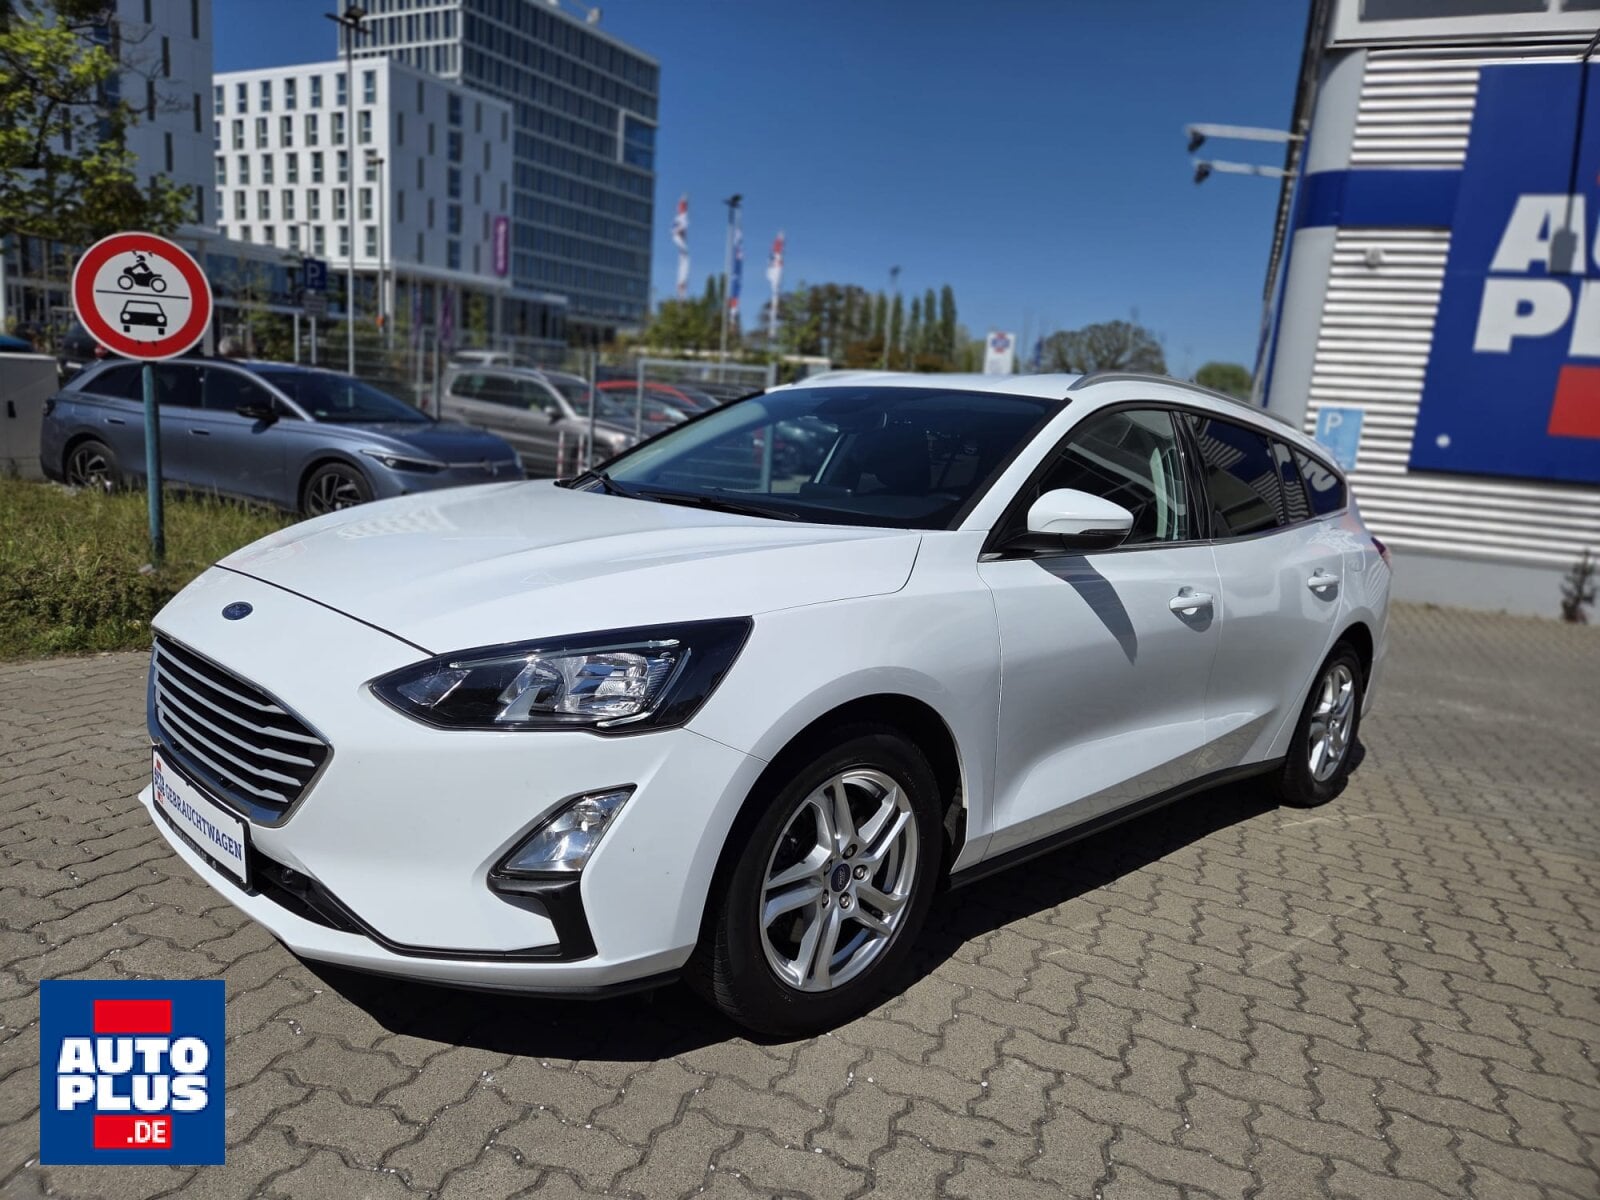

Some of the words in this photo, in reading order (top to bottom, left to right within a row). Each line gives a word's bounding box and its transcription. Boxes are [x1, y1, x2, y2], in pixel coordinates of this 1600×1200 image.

[1489, 194, 1600, 275] A
[306, 263, 320, 286] P
[1324, 412, 1343, 435] P
[166, 783, 242, 861] GEBRAUCHTWAGEN
